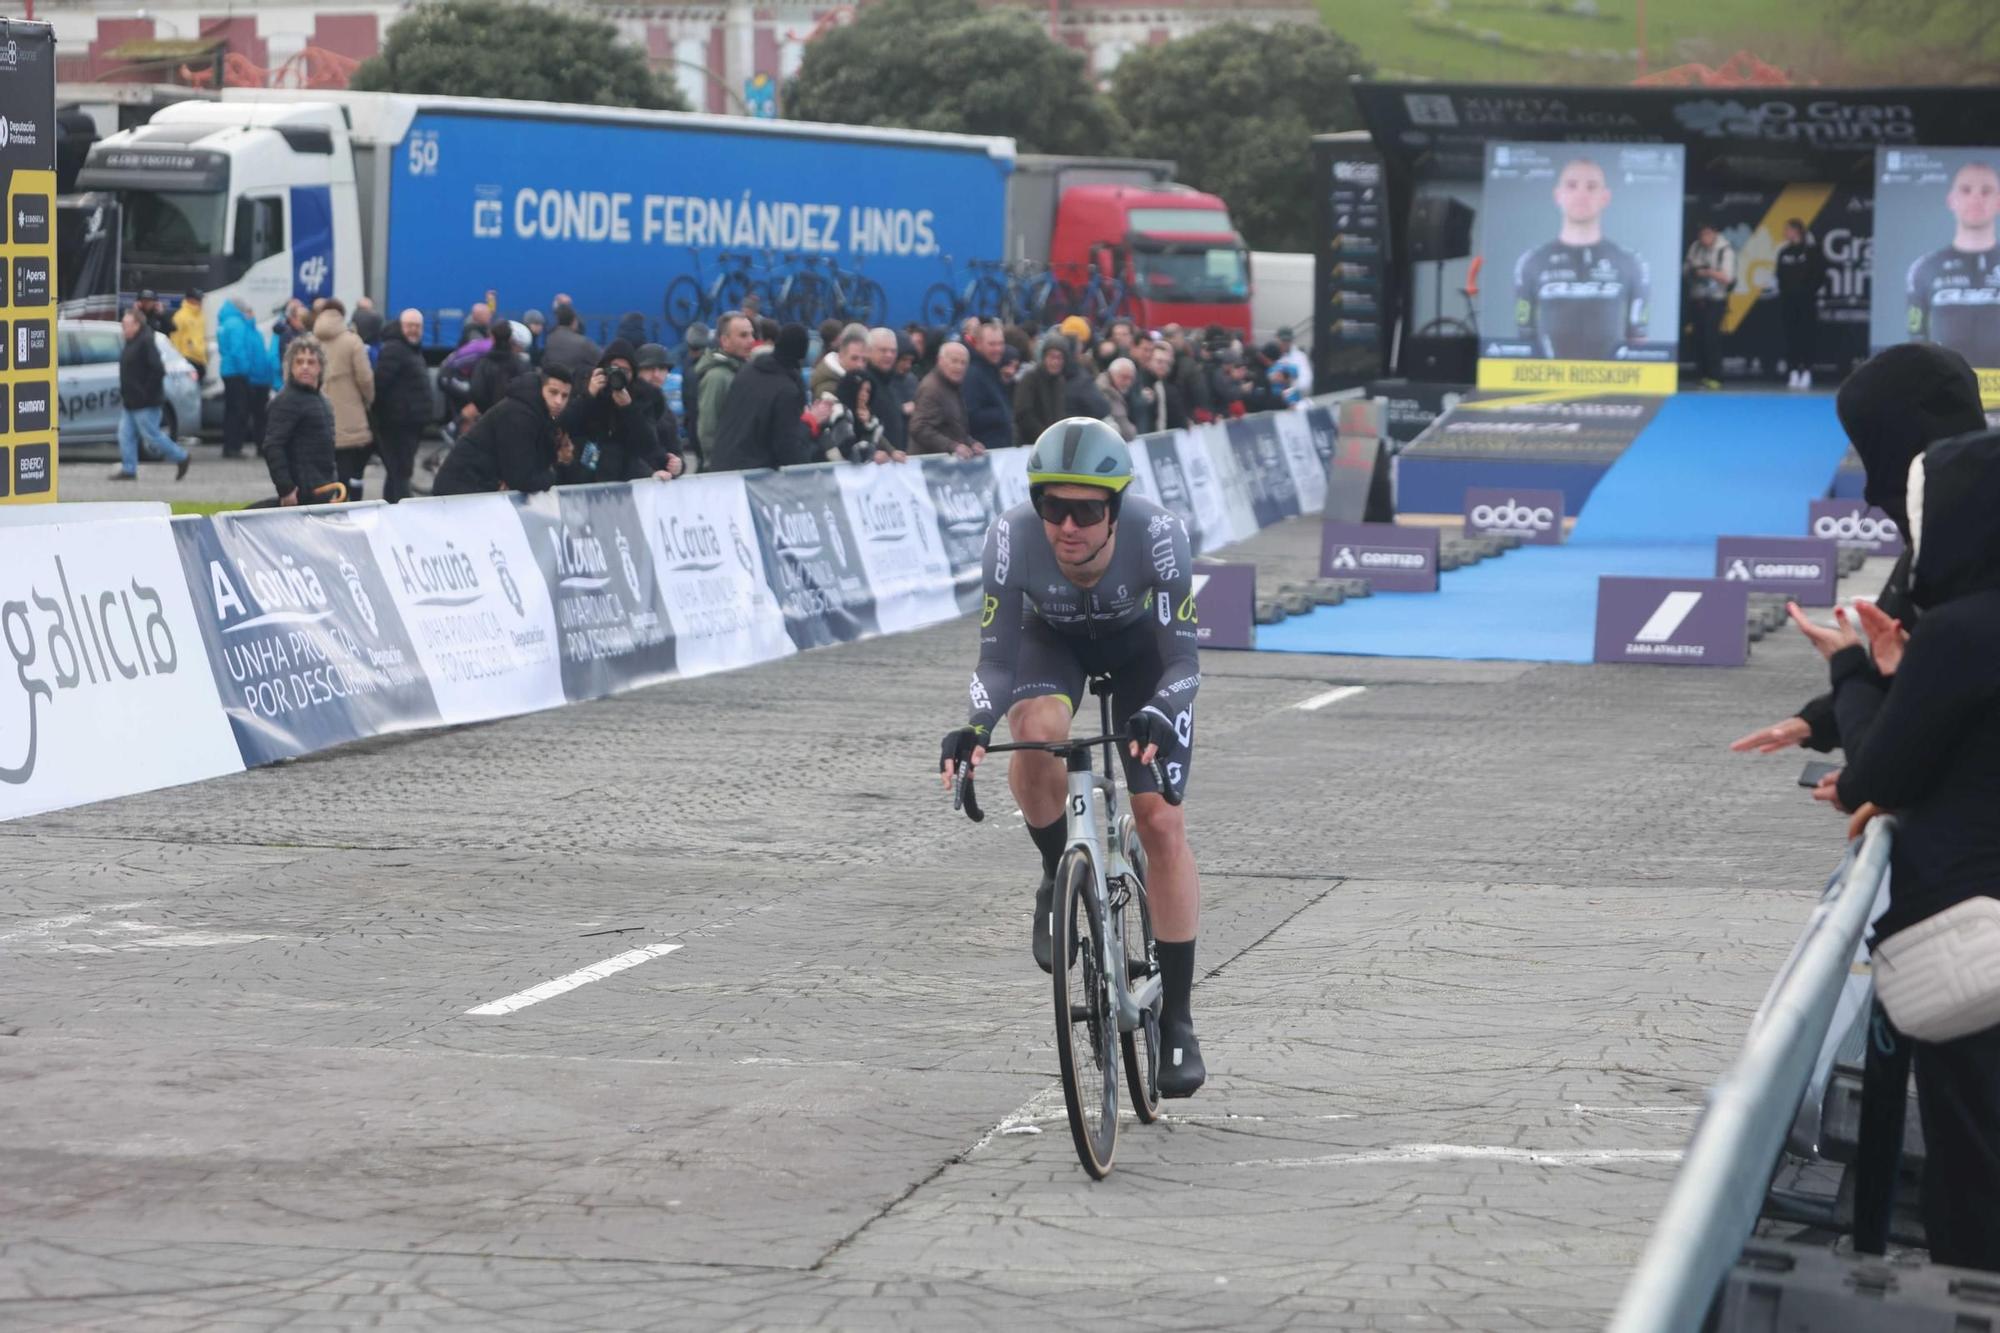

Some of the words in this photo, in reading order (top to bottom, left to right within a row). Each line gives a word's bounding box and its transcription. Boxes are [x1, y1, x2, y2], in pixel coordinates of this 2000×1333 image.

[409, 140, 439, 175] 50
[514, 187, 631, 241] CONDE
[642, 189, 840, 252] FERNÁNDEZ
[850, 205, 939, 256] HNOS.
[26, 269, 46, 284] Apersa
[1513, 364, 1565, 384] JOSEPH
[1568, 365, 1642, 386] ROSSKOPF
[18, 400, 45, 413] SHIMANO
[58, 387, 121, 421] Apers
[391, 545, 415, 595] A
[405, 541, 480, 593] Coruña
[1151, 536, 1180, 581] UBS
[1361, 552, 1425, 568] CORTIZO
[1754, 564, 1821, 579] CORTIZO
[209, 559, 247, 621] A
[238, 553, 328, 613] Coruña
[1052, 603, 1077, 613] UBS
[223, 635, 291, 682] UNHA
[1625, 643, 1652, 655] ZARA
[0, 553, 177, 785] galicia
[244, 678, 293, 719] POR
